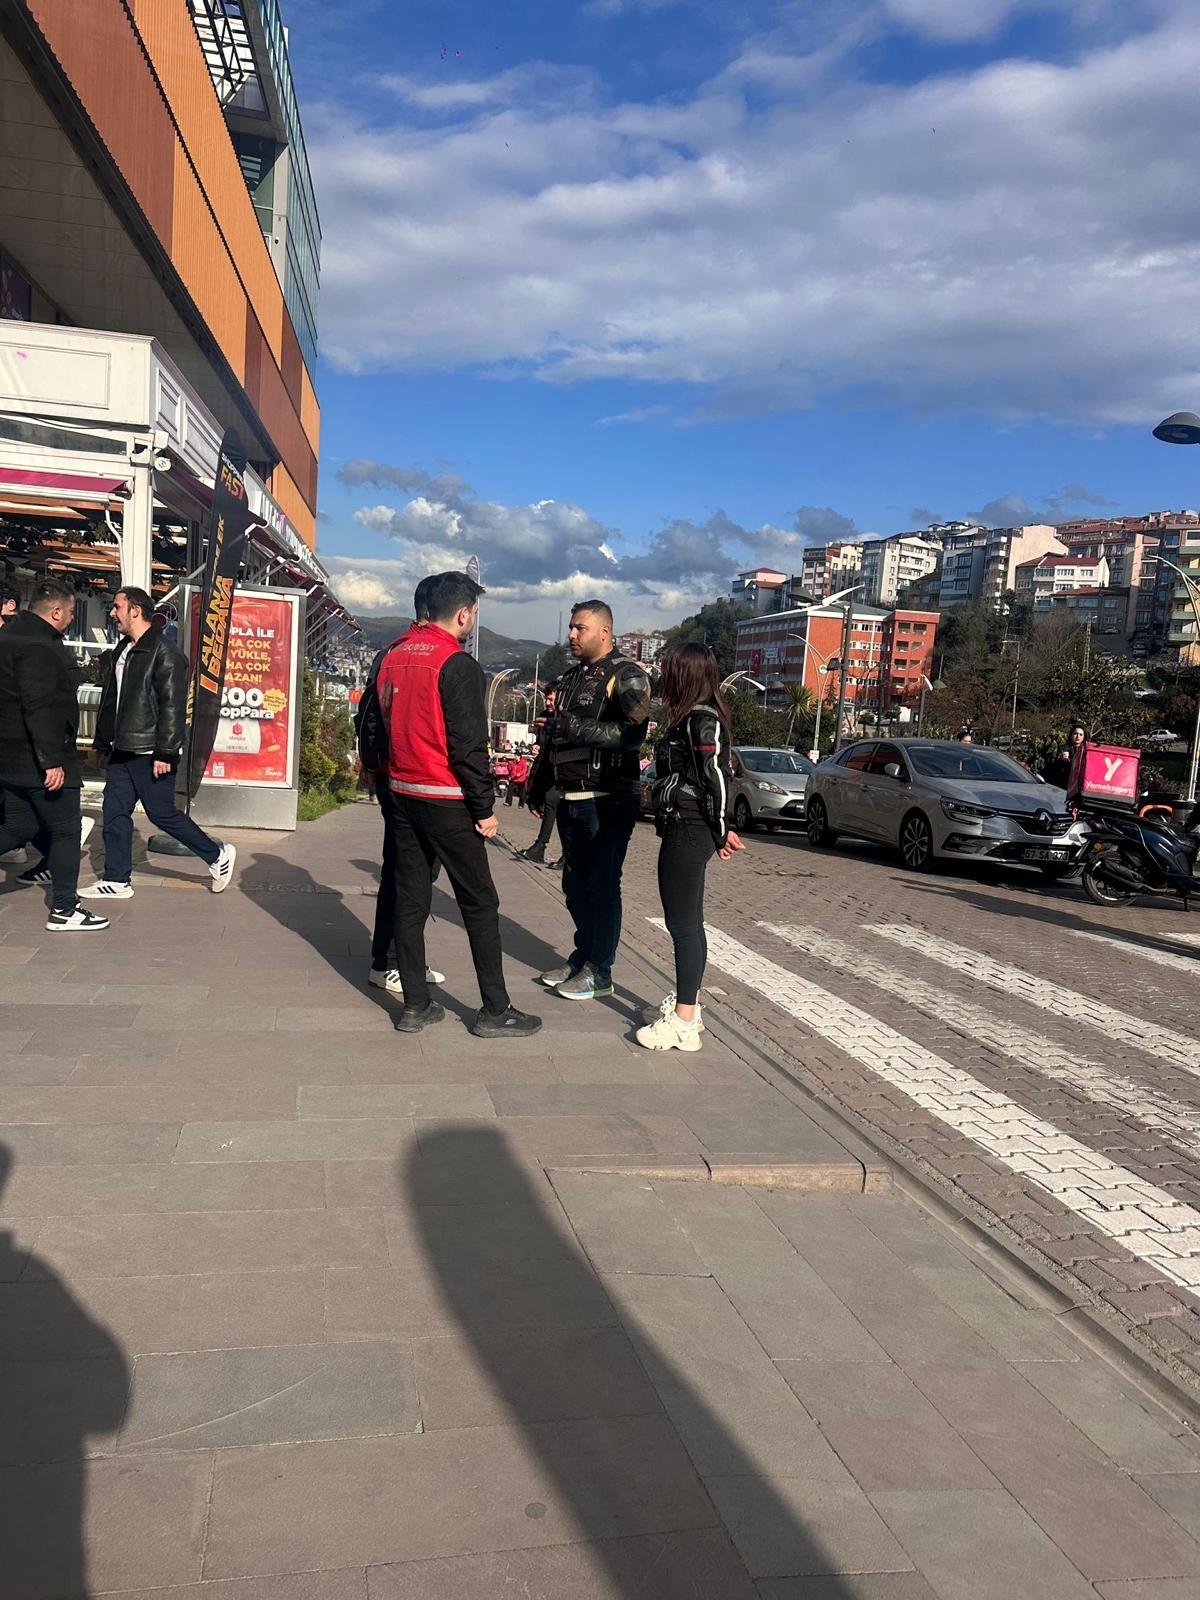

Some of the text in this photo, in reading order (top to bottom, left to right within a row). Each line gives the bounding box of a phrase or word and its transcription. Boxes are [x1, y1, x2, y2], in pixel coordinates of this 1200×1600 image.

[207, 578, 233, 678] BEDAVA
[230, 627, 275, 638] PLA İLE
[246, 640, 271, 651] ÇOK
